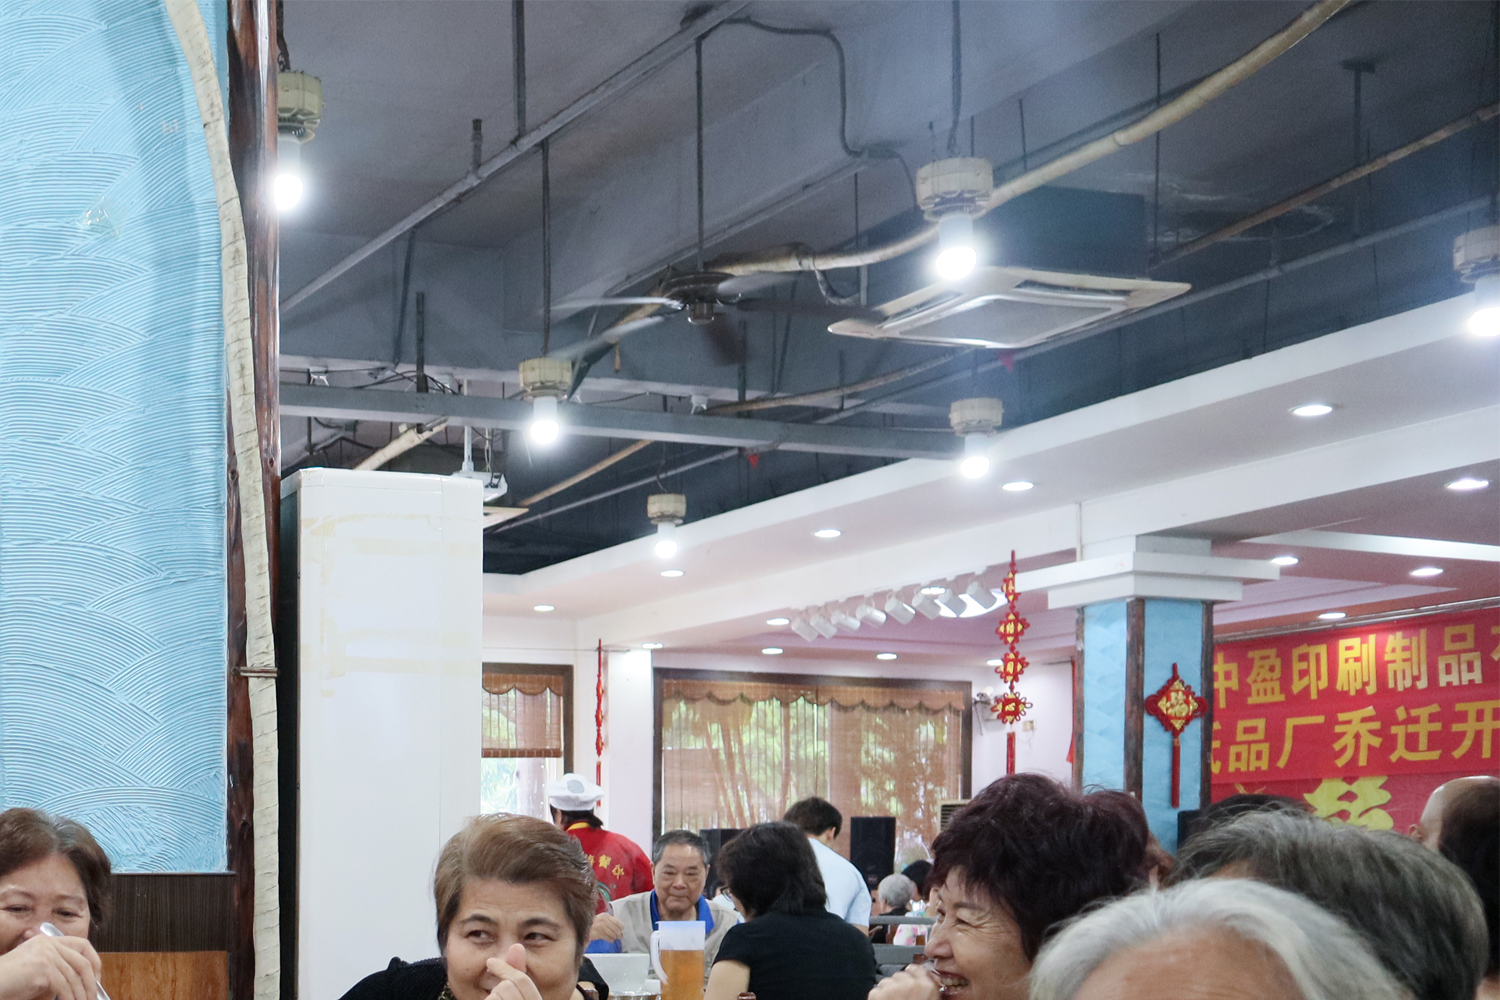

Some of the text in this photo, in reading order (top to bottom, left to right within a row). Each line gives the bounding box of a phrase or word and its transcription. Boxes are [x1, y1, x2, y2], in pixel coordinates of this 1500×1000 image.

[1213, 624, 1500, 709] 中盈印刷制品
